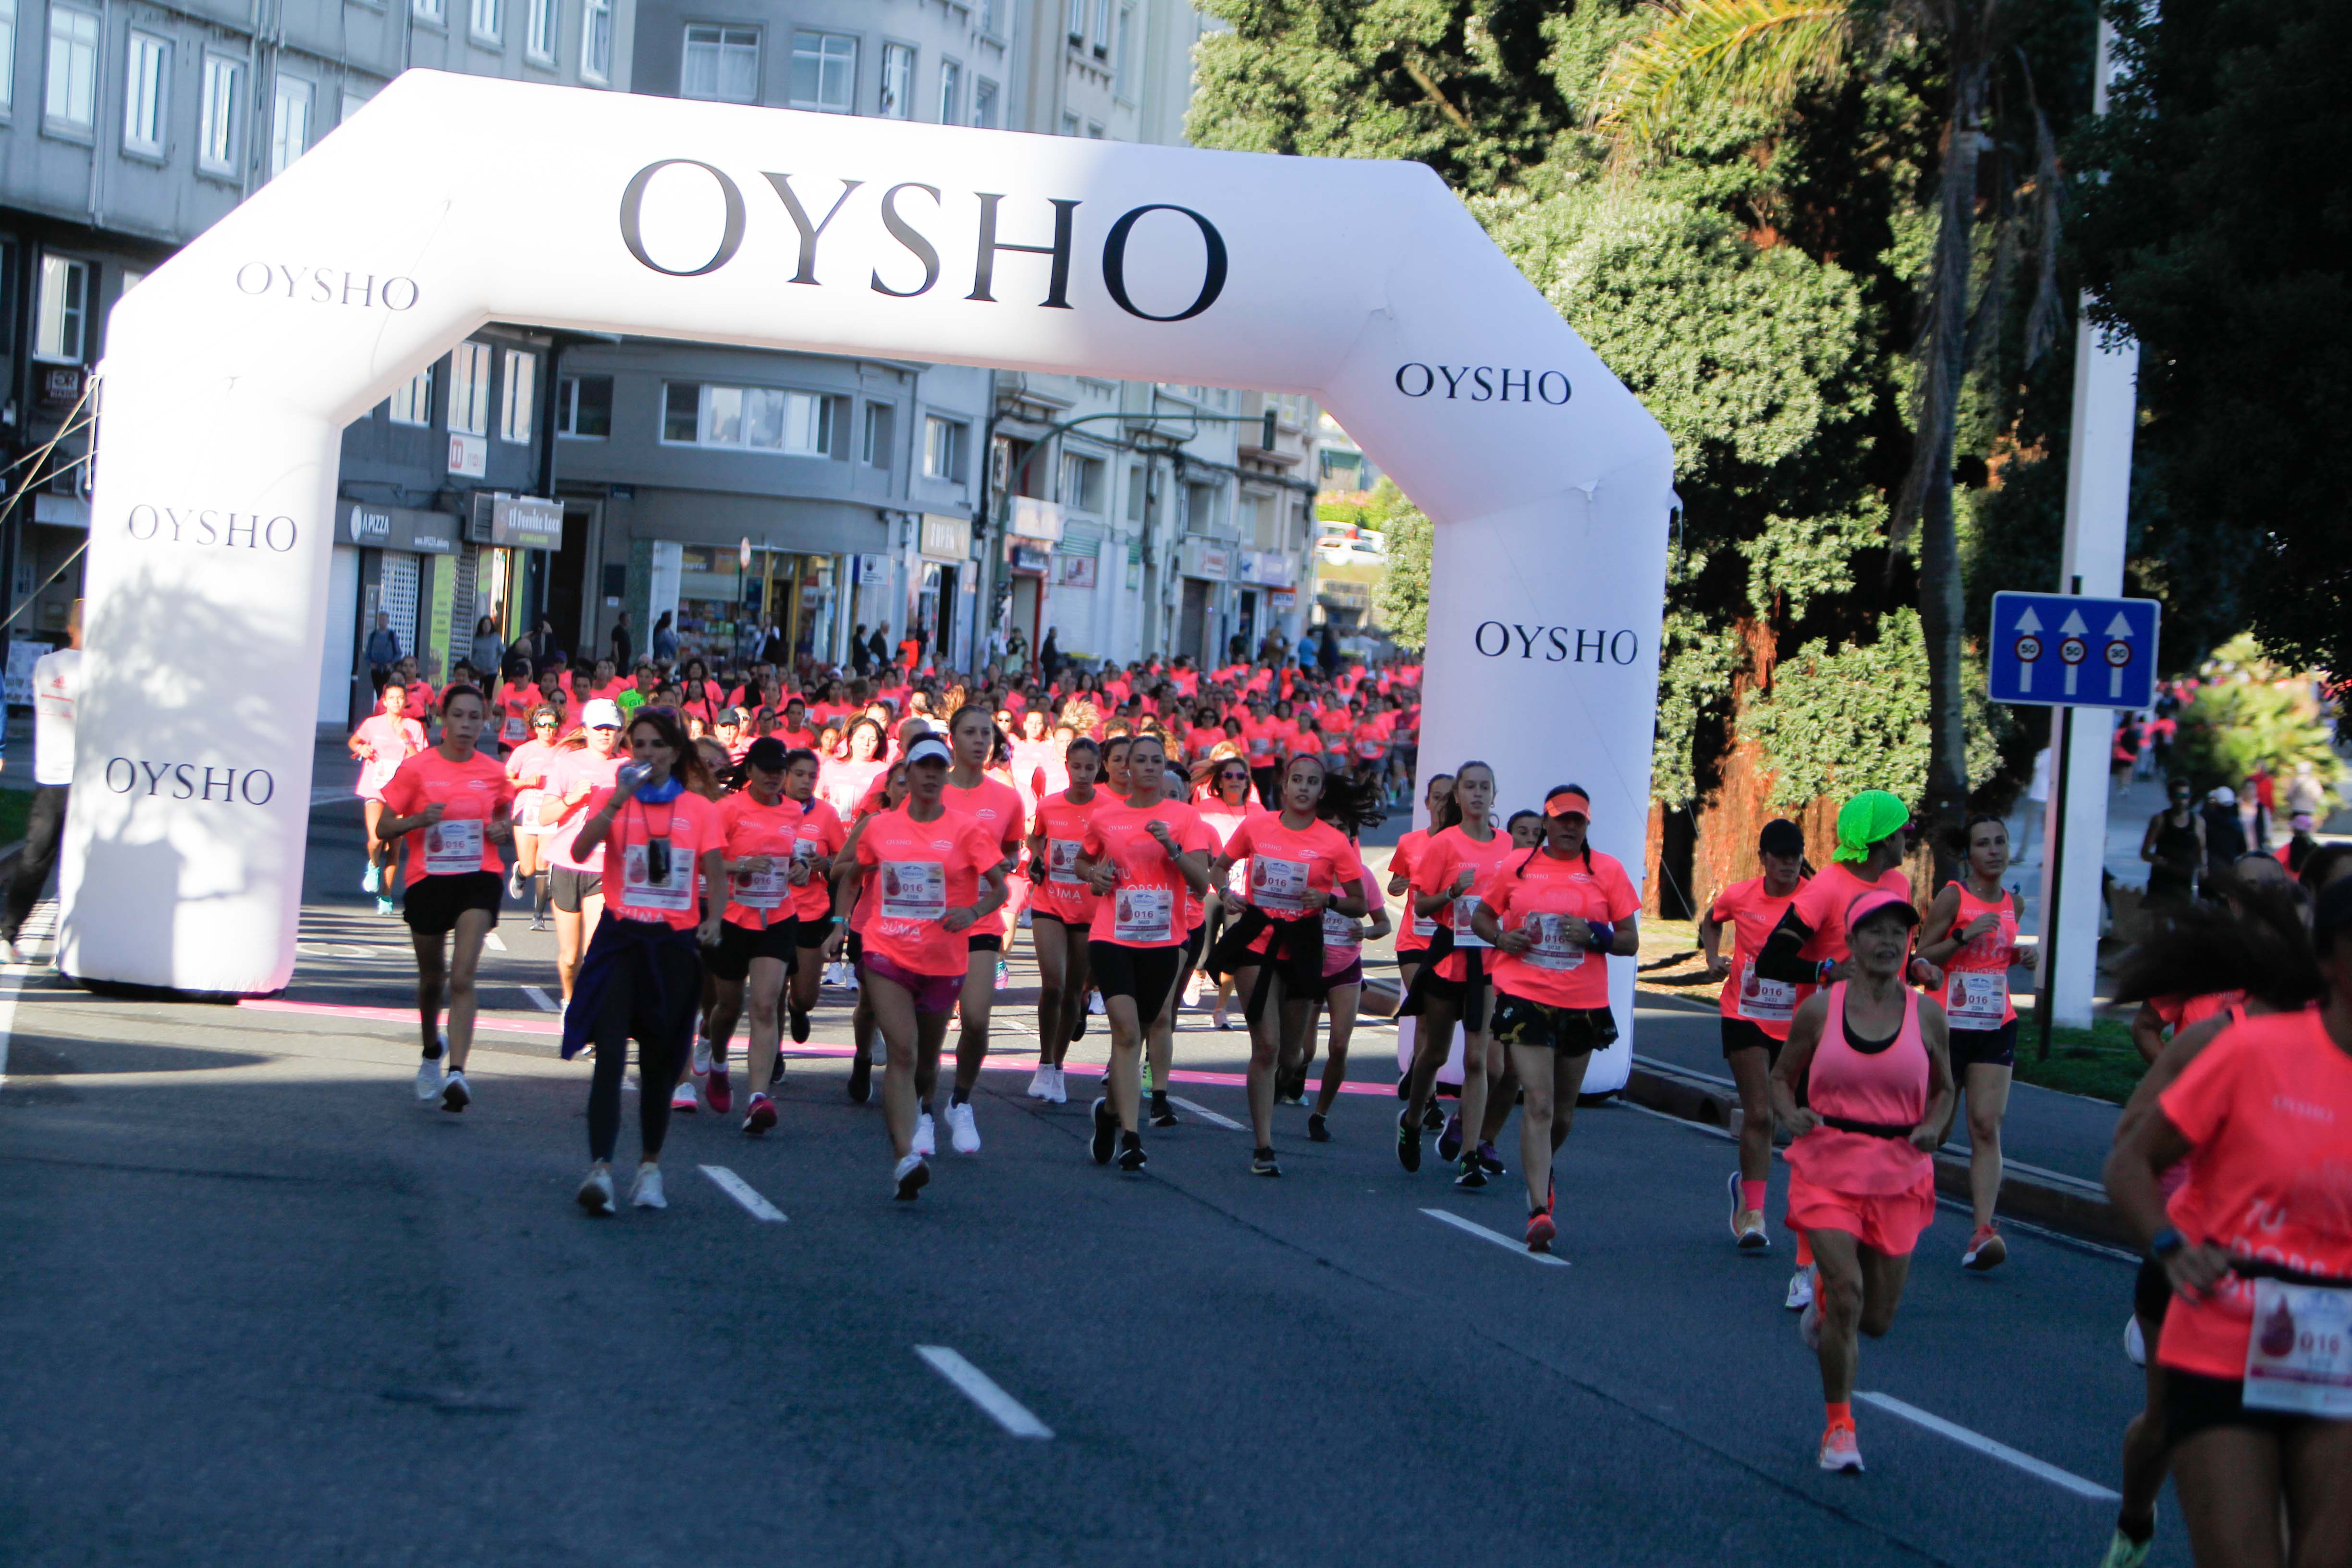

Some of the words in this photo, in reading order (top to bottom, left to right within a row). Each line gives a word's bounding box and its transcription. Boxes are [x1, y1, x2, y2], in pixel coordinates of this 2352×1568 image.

[619, 158, 1228, 323] OYSHO
[236, 262, 419, 311] OYSHO
[1395, 362, 1572, 405] OYSHO
[127, 504, 298, 552] OYSHO
[1475, 621, 1639, 665] OYSHO
[2021, 644, 2037, 654] 50
[2066, 646, 2082, 656] 50
[2111, 649, 2127, 659] 30
[105, 757, 275, 806] OYSHO
[445, 841, 466, 849] 016
[1259, 842, 1282, 851] OYSHO
[754, 876, 772, 885] 016
[903, 883, 923, 892] 016
[1268, 877, 1286, 886] 016
[881, 919, 921, 936] SUMA
[1544, 934, 1565, 943] 016
[1761, 987, 1782, 996] 016
[1968, 995, 1988, 1004] 016
[2299, 1330, 2340, 1357] 016
